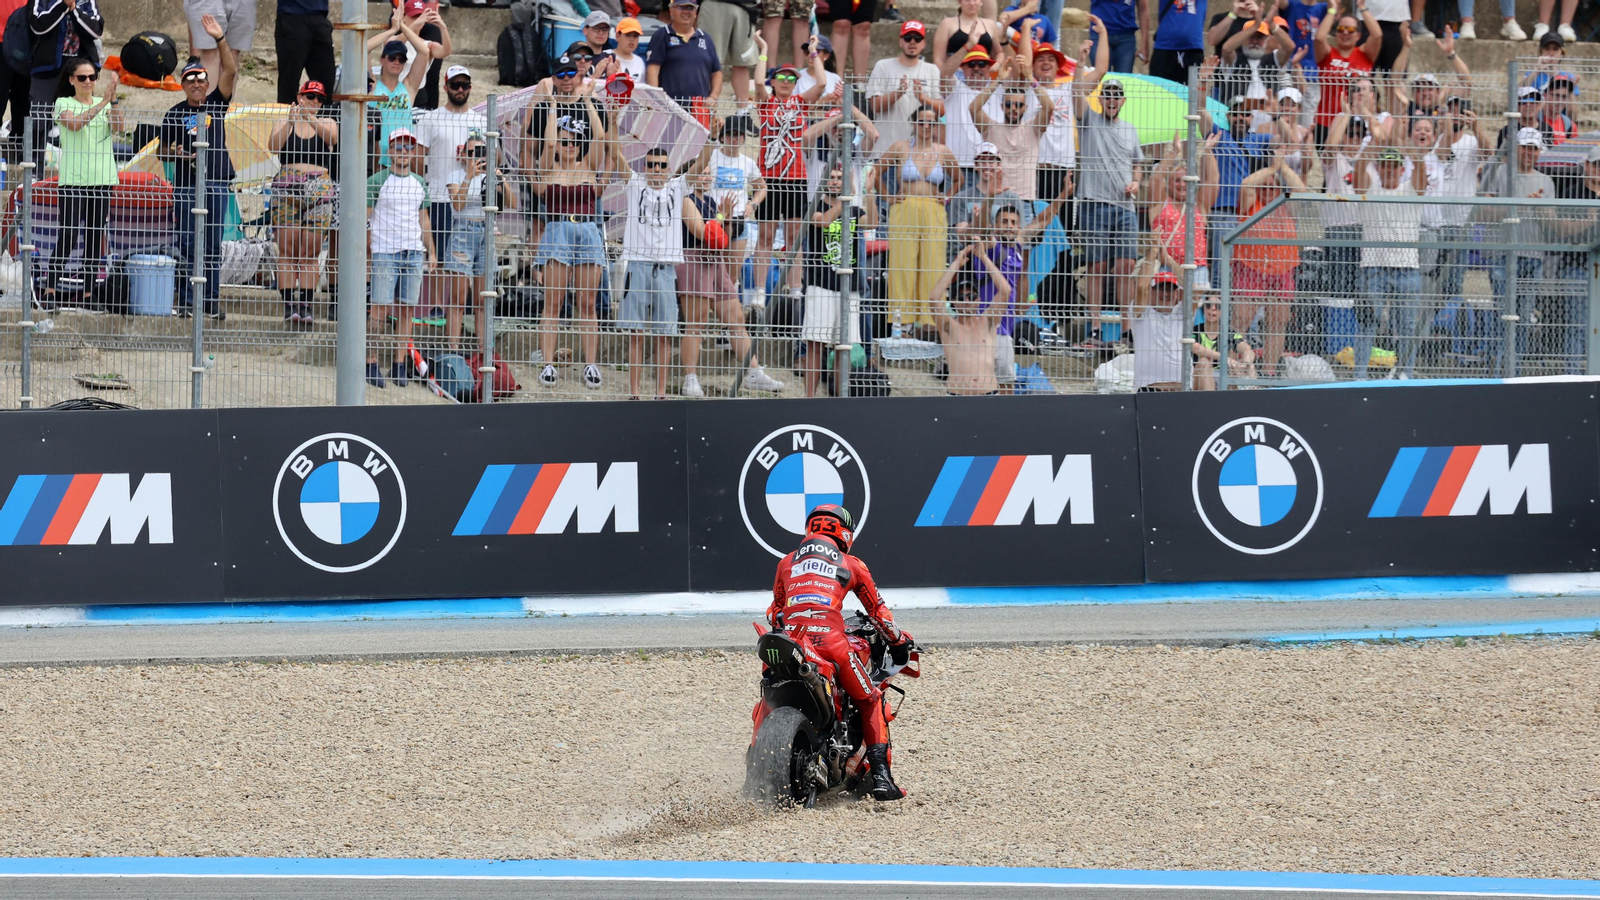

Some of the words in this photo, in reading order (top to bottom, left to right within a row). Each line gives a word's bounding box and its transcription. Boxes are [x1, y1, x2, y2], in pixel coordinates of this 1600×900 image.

[756, 432, 851, 470] BMW
[1209, 425, 1303, 462] BMW
[291, 441, 387, 479] BMW
[795, 543, 839, 560] Lenovo
[802, 560, 834, 575] riello
[796, 580, 813, 588] Audi
[813, 581, 836, 590] Sport
